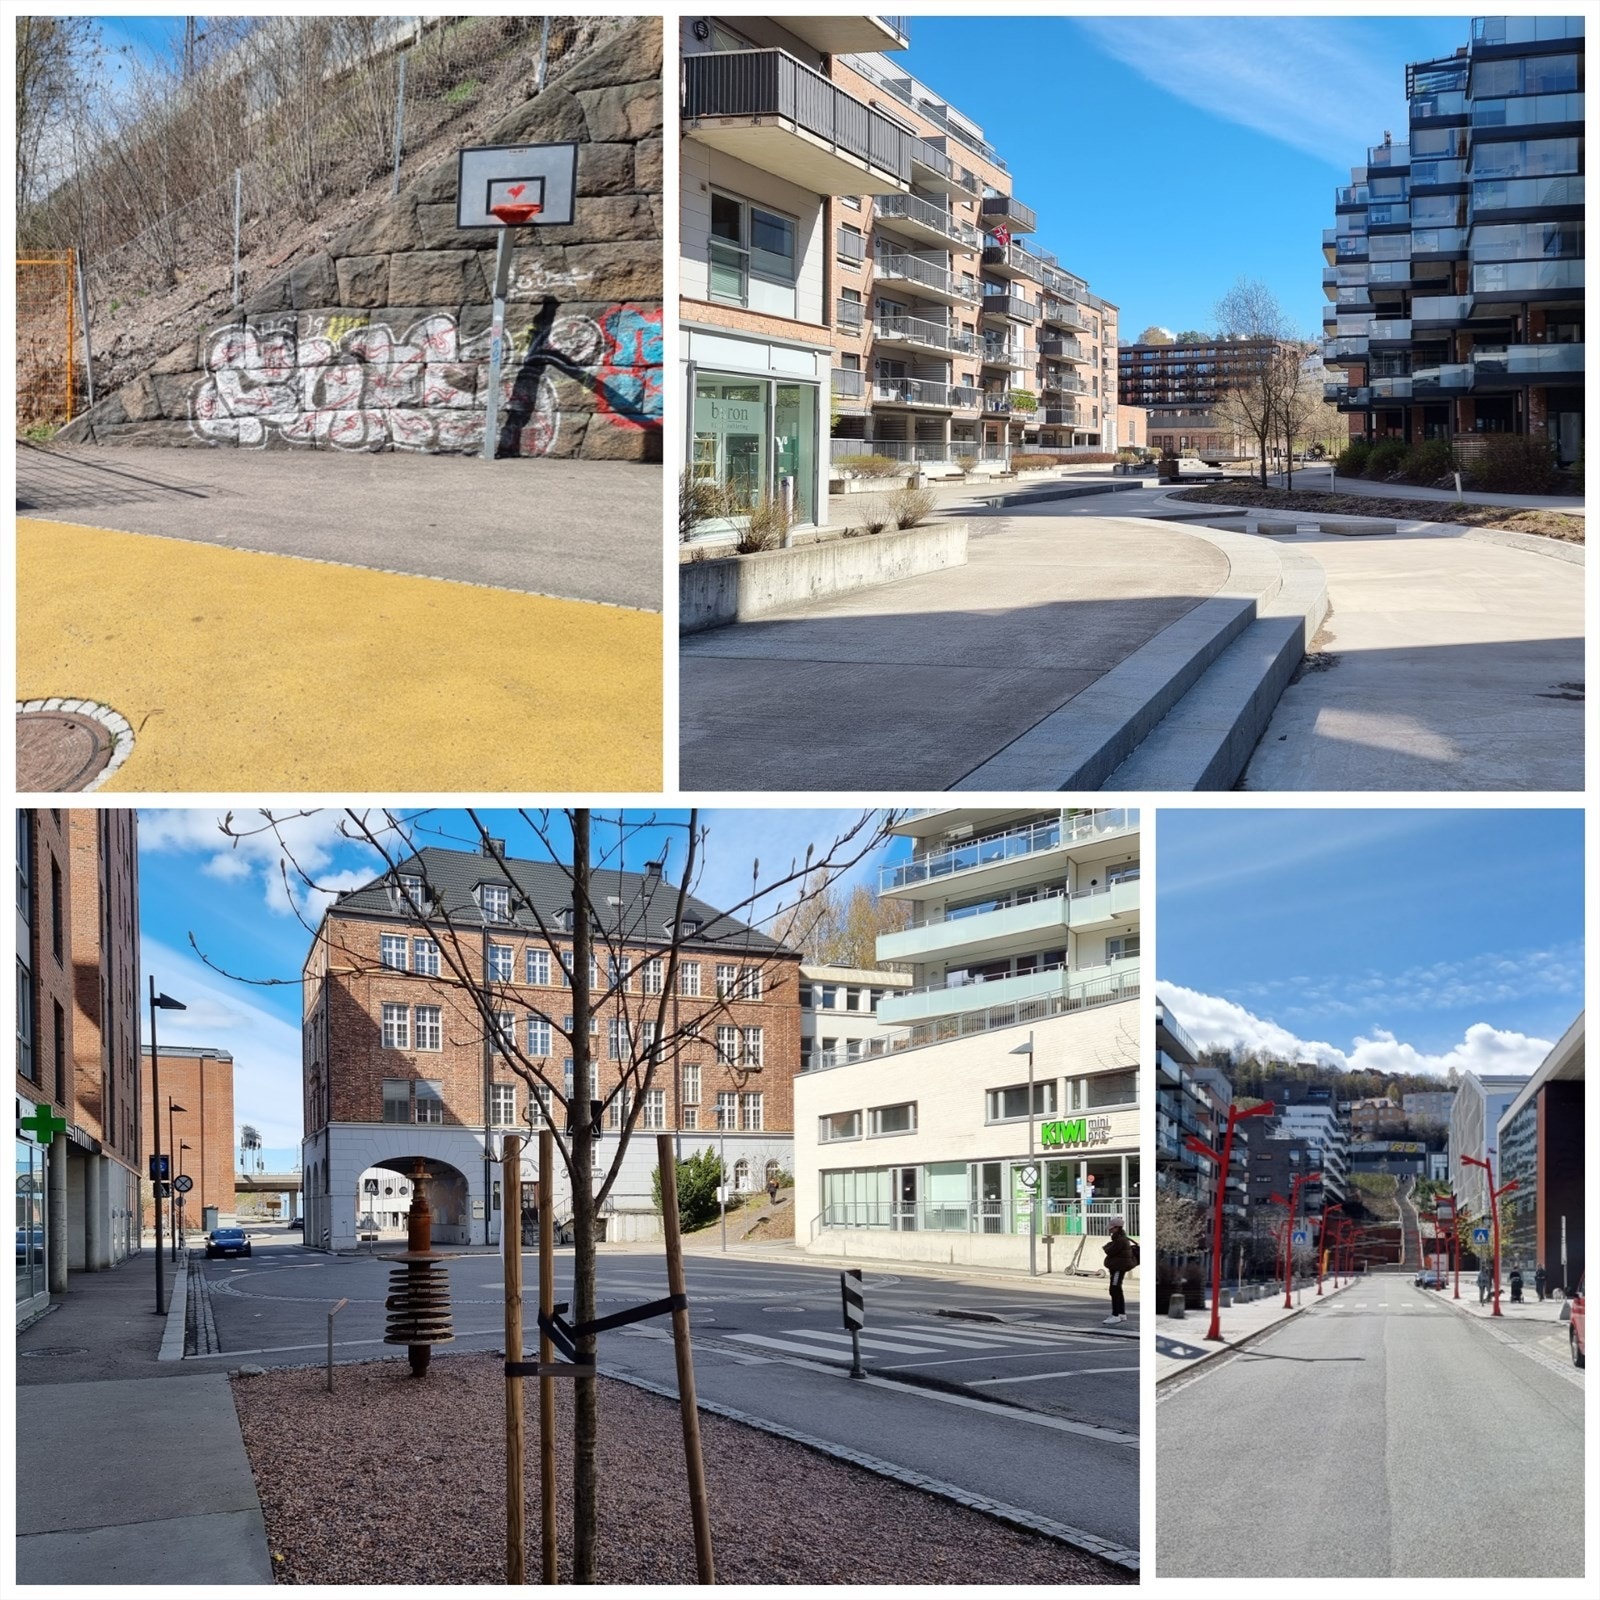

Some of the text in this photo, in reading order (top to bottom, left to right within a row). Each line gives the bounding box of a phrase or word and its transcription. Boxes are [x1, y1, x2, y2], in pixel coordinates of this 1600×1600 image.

[711, 401, 749, 421] bron
[1041, 1115, 1109, 1146] KIWI mini
[1088, 1130, 1107, 1142] pris
